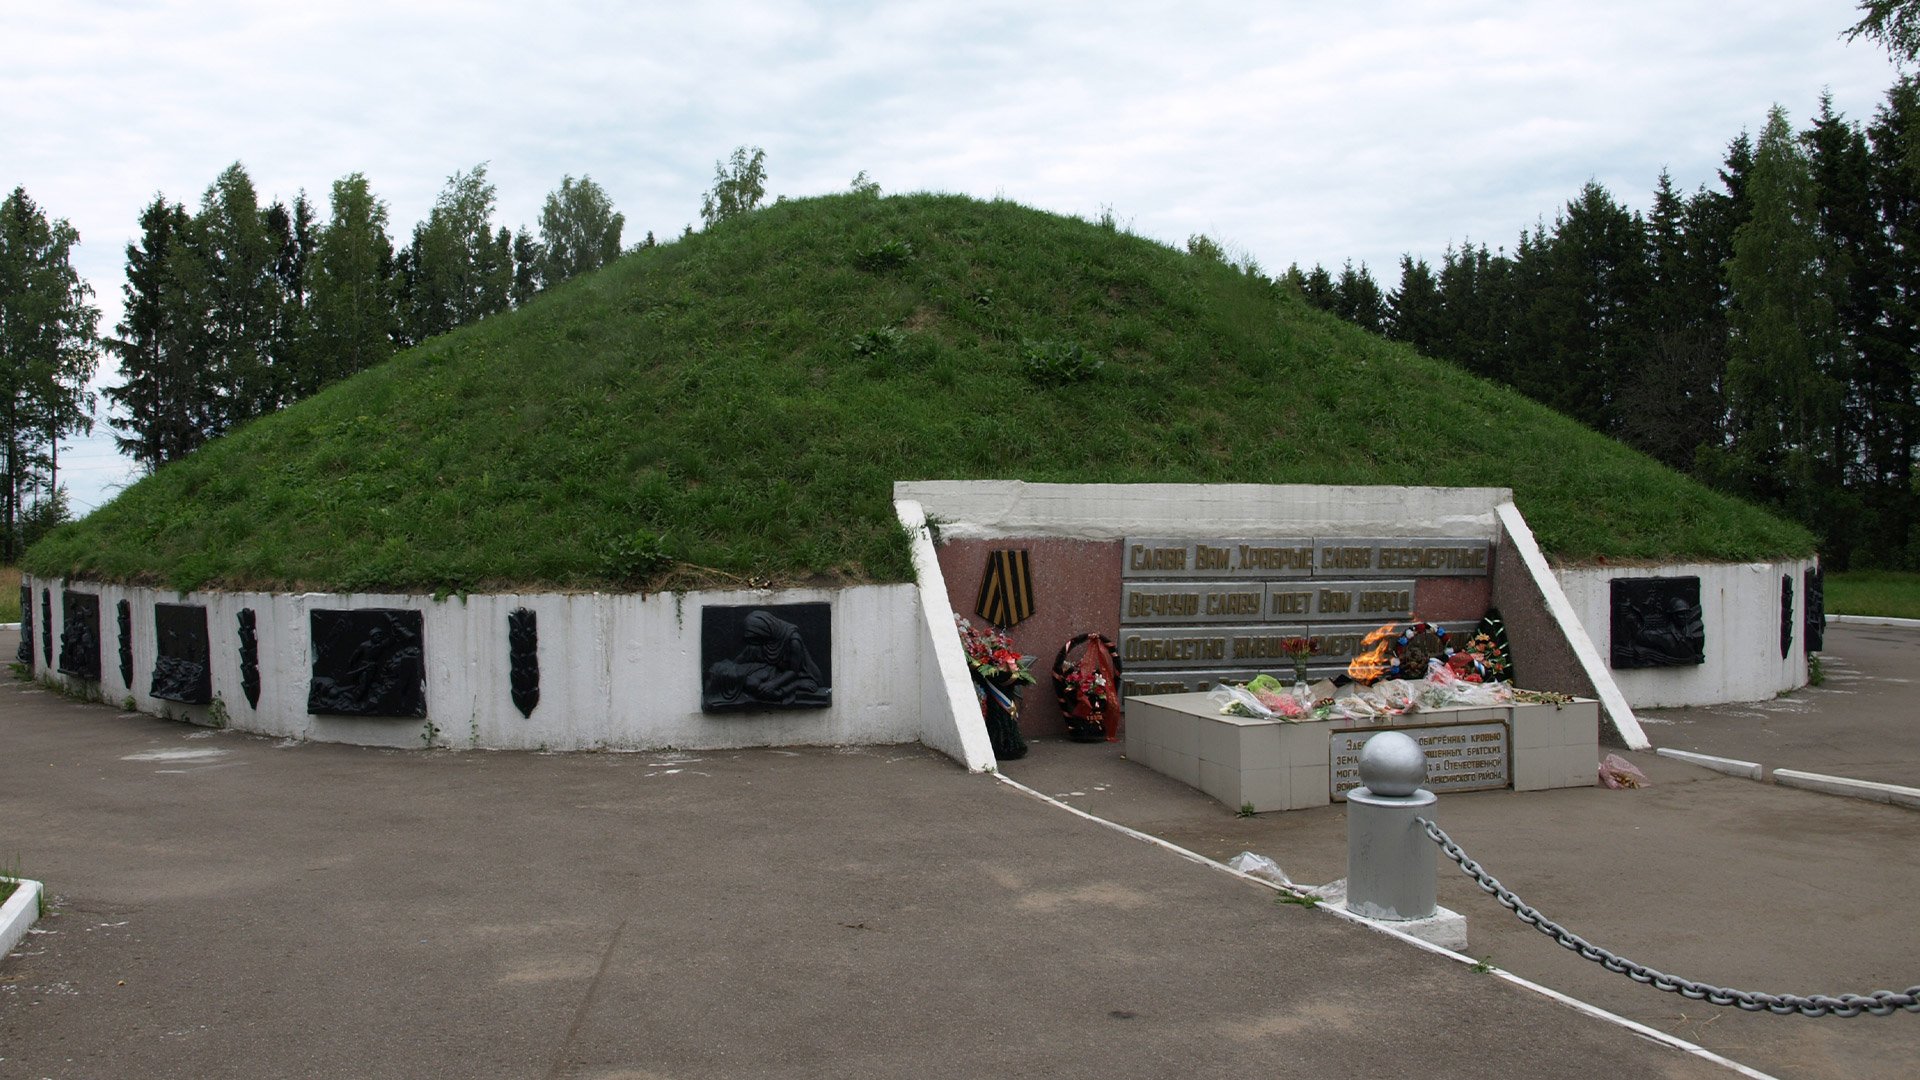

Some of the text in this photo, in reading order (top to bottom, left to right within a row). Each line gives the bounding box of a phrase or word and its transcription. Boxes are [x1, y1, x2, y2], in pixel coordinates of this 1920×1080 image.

[1130, 544, 1187, 570] СЛАВА
[1195, 544, 1236, 573] ВАМ,
[1321, 546, 1371, 569] СЛАВА
[1378, 546, 1487, 570] БЕССМЕРТНЫЕ
[1128, 588, 1410, 617] ВЕЧНУЮ СЛАВУ ПОЕТ ВАМ НАРОД
[1124, 635, 1226, 662] ДОБЛЕСТНО
[1471, 732, 1501, 743] КРОВЬЮ
[1467, 746, 1501, 756] БРАТСКИХ
[1444, 757, 1502, 771] ОТЕЧЕСТВЕННОЙ
[1478, 770, 1502, 781] РАЙОНА
